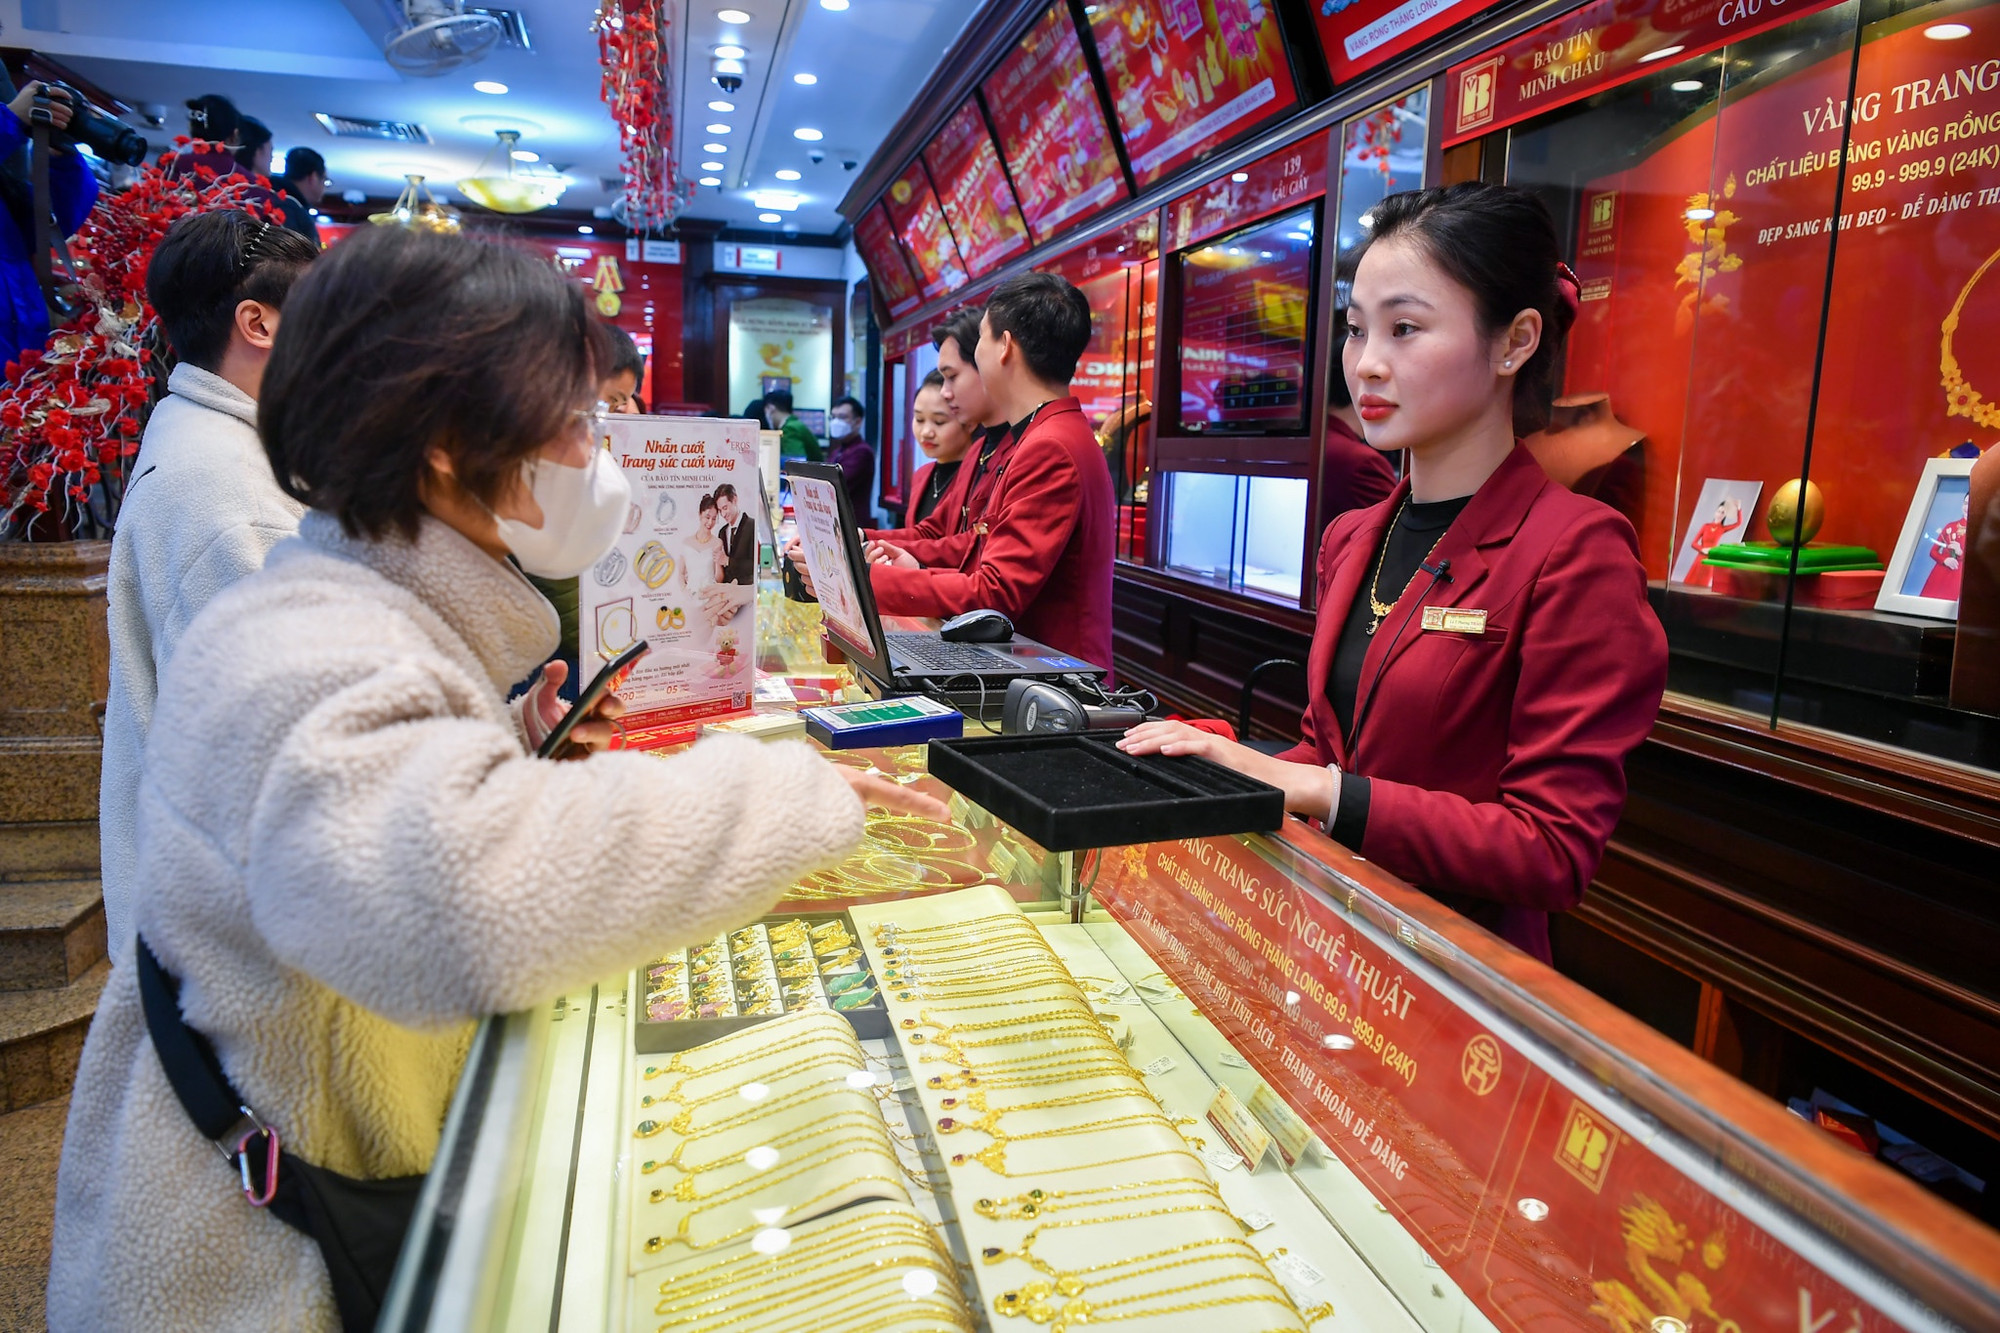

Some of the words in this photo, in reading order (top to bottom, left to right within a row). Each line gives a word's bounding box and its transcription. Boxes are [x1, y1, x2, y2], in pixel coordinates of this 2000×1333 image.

[1416, 0, 1438, 16] LONG
[1533, 41, 1563, 70] BẢO
[1567, 28, 1593, 51] TÍN
[1519, 72, 1557, 102] MINH
[1561, 52, 1606, 84] CHÂU
[1803, 92, 1882, 136] VÀNG
[1891, 59, 2000, 114] TRANG
[1284, 155, 1301, 177] 139
[1746, 157, 1787, 187] CHẤT
[1789, 152, 1825, 179] LIỆU
[1829, 138, 1882, 167] BẰNG
[1886, 126, 1939, 155] VÀNG
[1944, 110, 2000, 142] RỒNG
[1852, 169, 1885, 193] 99.9
[1899, 157, 1945, 183] 999.9
[1949, 144, 2000, 177] (24K)
[1758, 226, 1783, 247] ĐẸP
[1785, 218, 1819, 240] SANG
[1823, 213, 1853, 232] KHI
[1856, 207, 1886, 228] ĐEO
[1900, 193, 1924, 220] DỄ
[1926, 191, 1972, 216] DÀNG
[622, 455, 656, 471] Trang
[659, 455, 678, 468] sức
[681, 455, 705, 468] cưới
[708, 456, 735, 471] vàng
[645, 438, 677, 453] Nhẫn
[681, 441, 705, 453] cưới
[1213, 851, 1260, 902] TRANG
[1259, 887, 1292, 926] SỨC
[1290, 914, 1346, 972] NGHỆ
[1346, 950, 1416, 1021] THUẬT
[1158, 852, 1177, 876] CHẤT
[1174, 868, 1192, 889] LIỆU
[1190, 877, 1213, 908] BẰNG
[1212, 897, 1236, 928] VÀNG
[1234, 916, 1262, 950] RỒNG
[1261, 938, 1294, 977] THĂNG
[1293, 965, 1325, 1002] LONG
[1323, 992, 1347, 1023] 99.9
[1352, 1016, 1384, 1054] 999.9
[1381, 1041, 1418, 1087] (24K)
[1132, 900, 1144, 919] TỰ
[1140, 907, 1155, 928] TIN
[1150, 918, 1170, 944] SANG
[1167, 931, 1190, 965] TRỌNG
[1193, 960, 1214, 990] KHẮC
[1230, 997, 1253, 1026] TÍNH
[1251, 1017, 1276, 1050] CÁCH
[1279, 1045, 1316, 1089] THANH
[1313, 1079, 1355, 1128] KHOẢN
[1352, 1117, 1376, 1145] DỄ
[1370, 1135, 1409, 1181] DÀNG
